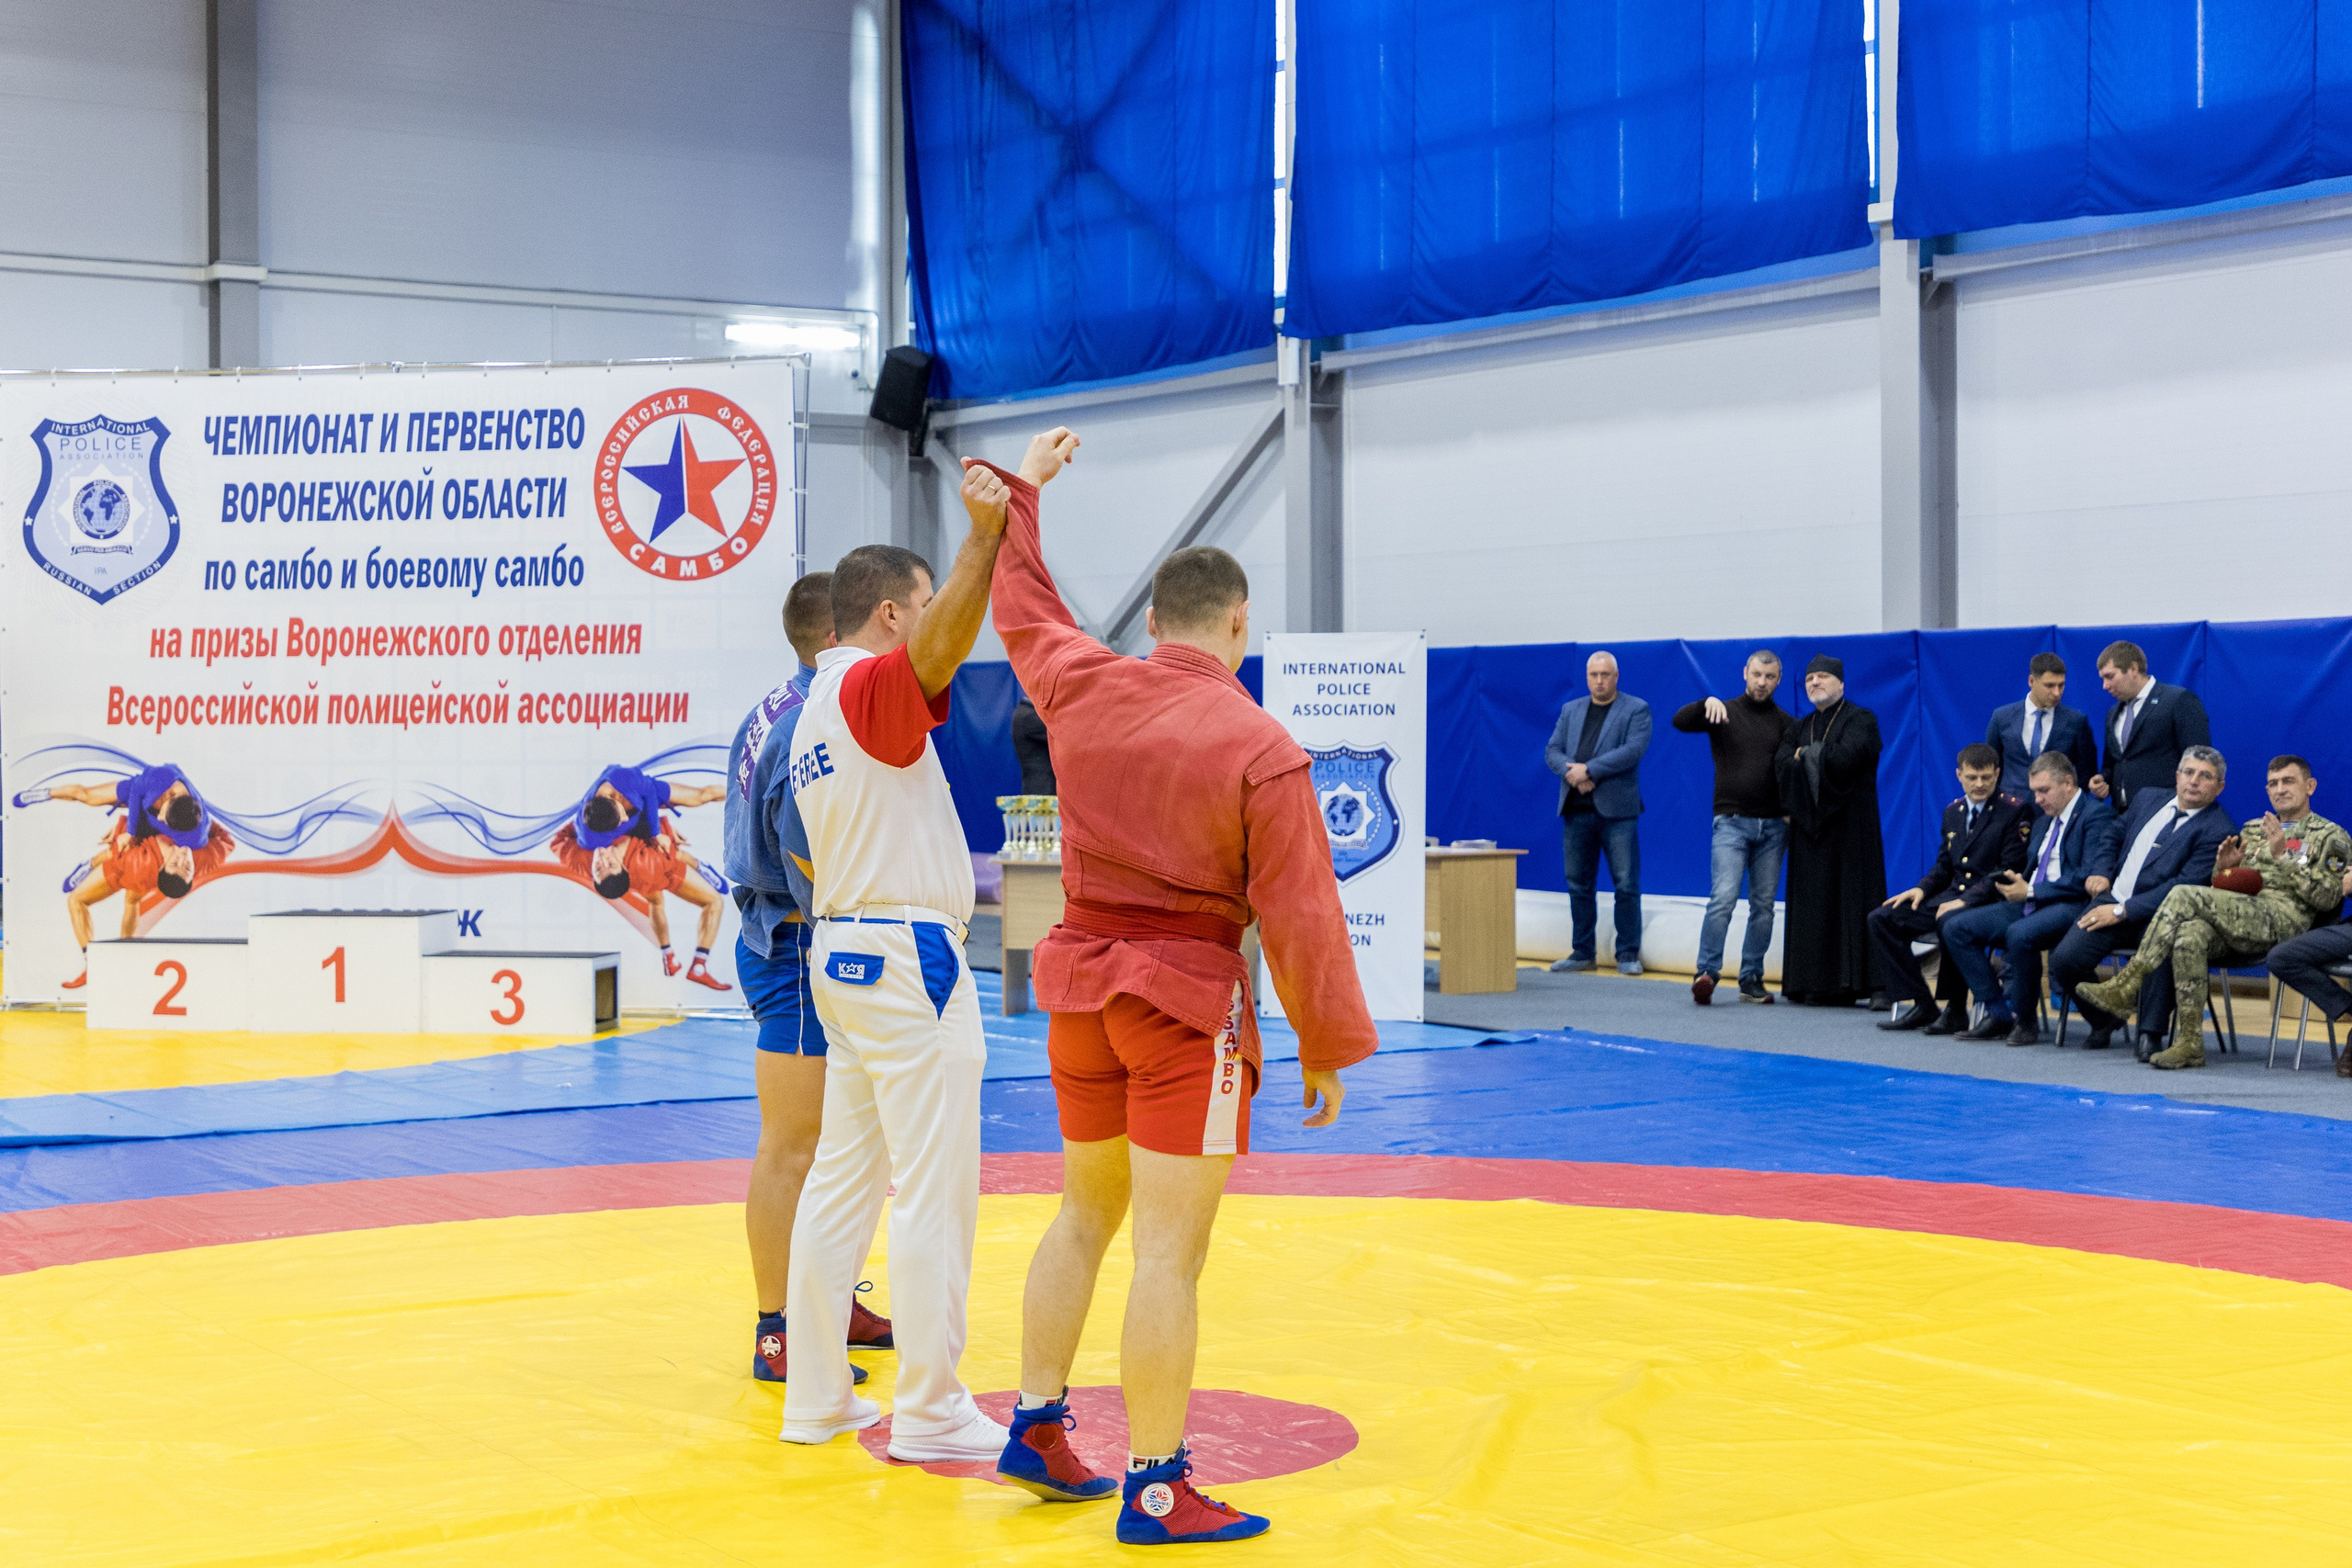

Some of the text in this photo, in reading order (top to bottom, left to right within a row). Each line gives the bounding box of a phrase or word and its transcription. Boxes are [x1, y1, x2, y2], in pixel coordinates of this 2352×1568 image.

[51, 417, 150, 435] INTERNATIONAL
[60, 436, 141, 451] POLICE
[204, 407, 585, 456] ЧЕМПИОНАТ И ПЕРВЕНСТВО
[600, 394, 771, 535] ВСЕРОССИЙСКАЯ ФЕДЕРАЦИЯ
[221, 467, 567, 524] ВОРОНЕЖСКОЙ ОБЛАСТИ
[42, 560, 162, 596] RUSSIAN SECTION
[94, 566, 107, 575] IPA
[204, 543, 584, 598] по самбо и боевому самбо
[629, 536, 749, 578] САМБО
[150, 617, 641, 668] на призы Воронежского отделения
[1283, 660, 1407, 676] INTERNATIONAL
[1317, 682, 1371, 696] POLICE
[107, 682, 688, 735] Всероссийской полицейской ассоциации
[1292, 703, 1396, 717] ASSOCIATION
[1315, 761, 1375, 773] POLICE
[1344, 913, 1385, 926] NEZH
[153, 960, 187, 1017] 2
[321, 945, 346, 1004] 1
[491, 968, 526, 1026] 3
[1221, 1015, 1238, 1095] SAMBO
